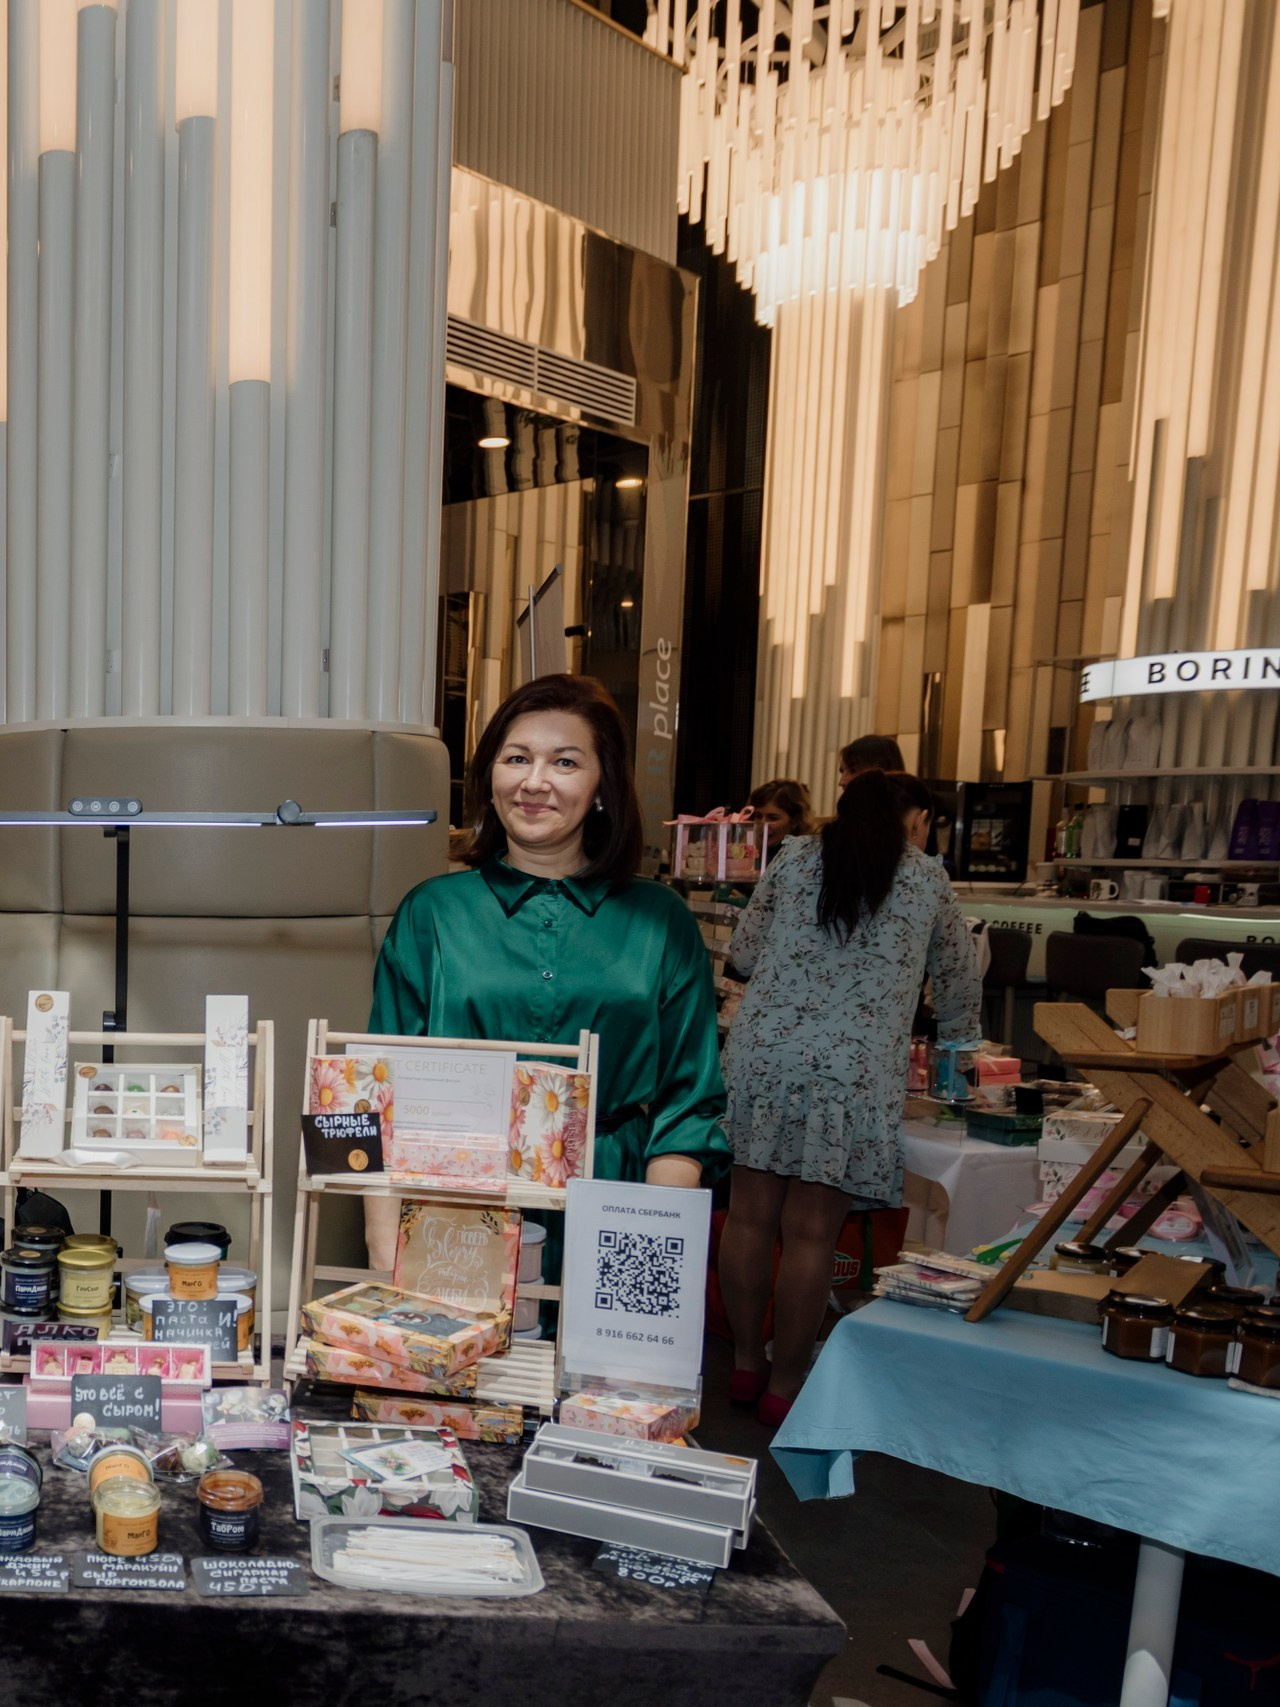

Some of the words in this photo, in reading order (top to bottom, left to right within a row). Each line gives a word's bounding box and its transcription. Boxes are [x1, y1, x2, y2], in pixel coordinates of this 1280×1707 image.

[649, 637, 672, 740] place
[405, 1060, 489, 1075] CERTIFICATE
[403, 1104, 430, 1116] 5000
[314, 1113, 370, 1128] СЫРНЫЕ
[321, 1125, 378, 1139] ТРЮФЕЛИ
[601, 1204, 637, 1216] ОПЛАТА
[638, 1208, 681, 1219] СБЕРБАНК
[14, 1324, 97, 1337] АЛКО
[154, 1328, 223, 1341] НАЧИНКА
[596, 1327, 603, 1337] 8
[605, 1328, 624, 1339] 916
[625, 1331, 645, 1342] 662
[646, 1334, 659, 1344] 64
[661, 1336, 674, 1346] 66
[75, 1386, 96, 1402] ЭТО
[100, 1384, 125, 1401] ВСЁ
[102, 1398, 160, 1420] СЫРОМ!
[86, 1554, 126, 1564] ПЮРЕ
[82, 1571, 117, 1579] СЫР
[210, 1569, 288, 1577] СИГАРНАЯ
[96, 1578, 185, 1588] ГОРГОНЗОЛА
[239, 1577, 288, 1585] ПАСТА
